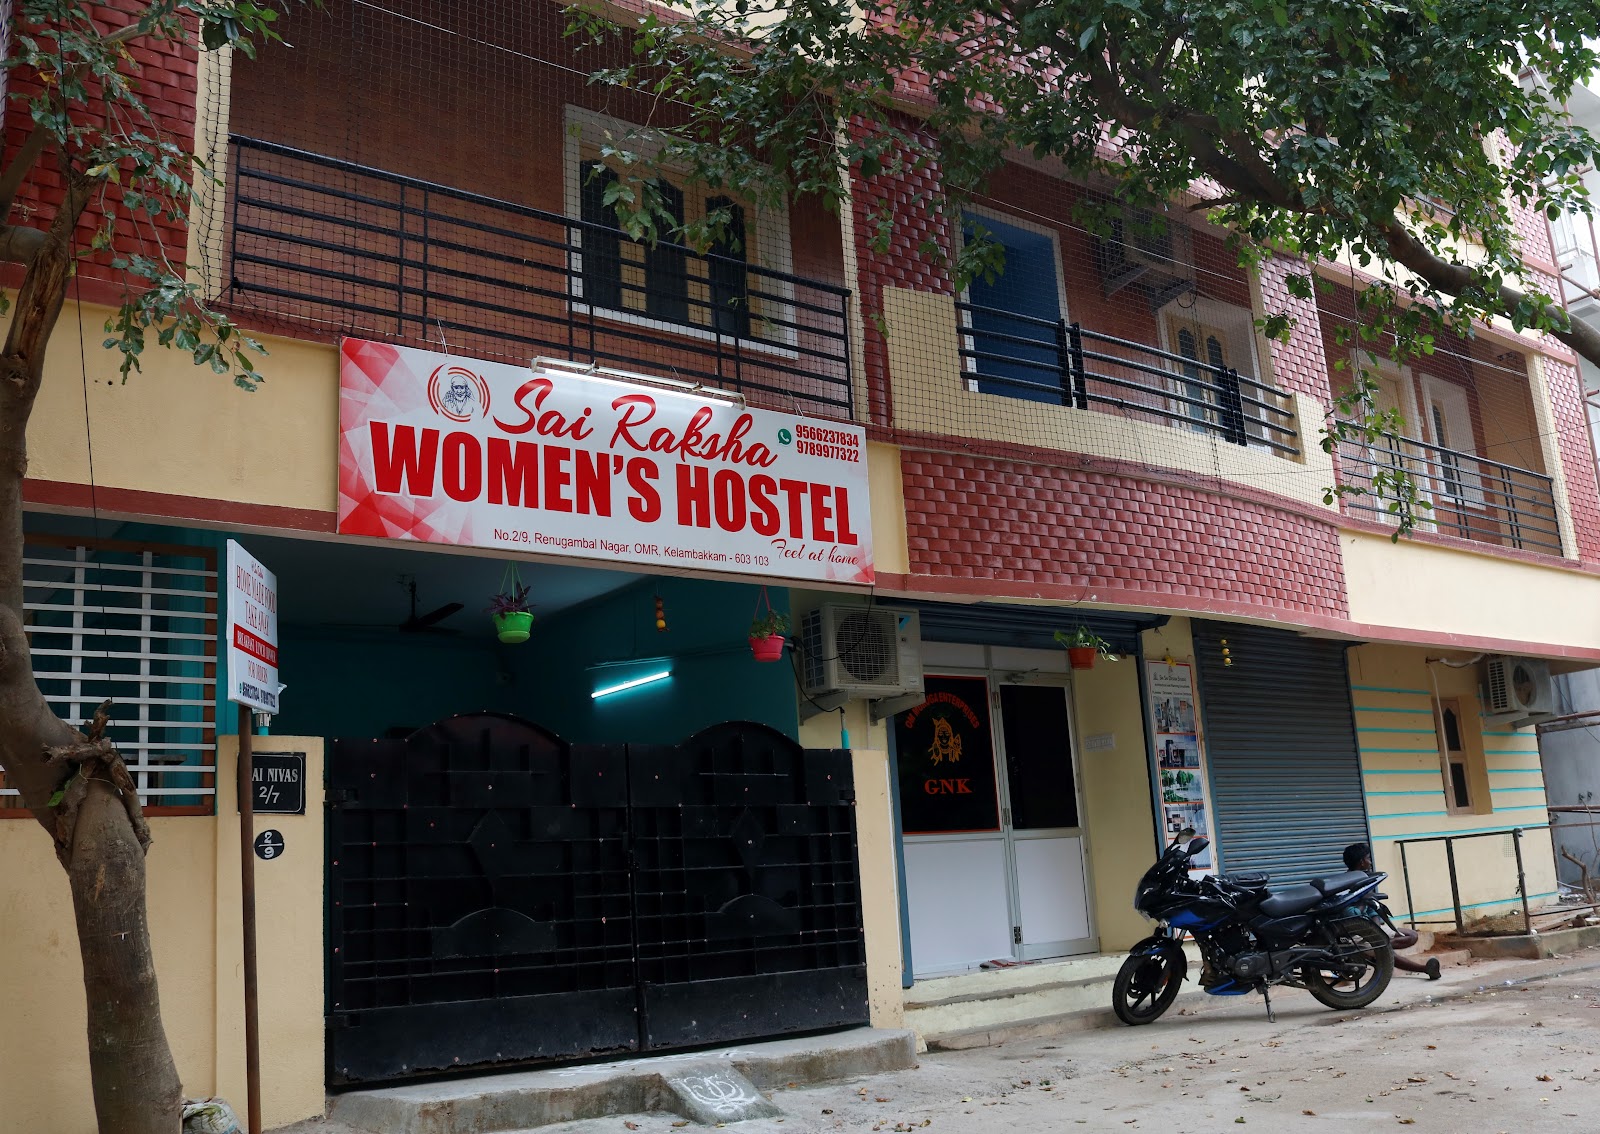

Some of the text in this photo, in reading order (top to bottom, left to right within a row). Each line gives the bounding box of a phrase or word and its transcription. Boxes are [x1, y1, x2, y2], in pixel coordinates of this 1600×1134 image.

[493, 378, 778, 468] Sai Raksha
[795, 424, 859, 447] 9566237834
[796, 440, 860, 463] 9789977322
[368, 420, 858, 546] WOMEN'S HOSTEL
[494, 528, 531, 544] No.2/9,
[534, 532, 597, 549] Renugambal
[600, 539, 631, 555] Nagar,
[634, 543, 661, 557] OMR,
[664, 546, 727, 562] Kelambakkam
[735, 553, 751, 565] 603
[754, 555, 769, 566] 103
[771, 538, 859, 566] Feel at home
[237, 565, 251, 597] HOME
[938, 692, 980, 729] ENTERPRISES
[252, 767, 299, 783] AI NIVAS
[924, 778, 973, 795] GNK
[258, 784, 280, 805] 2/7
